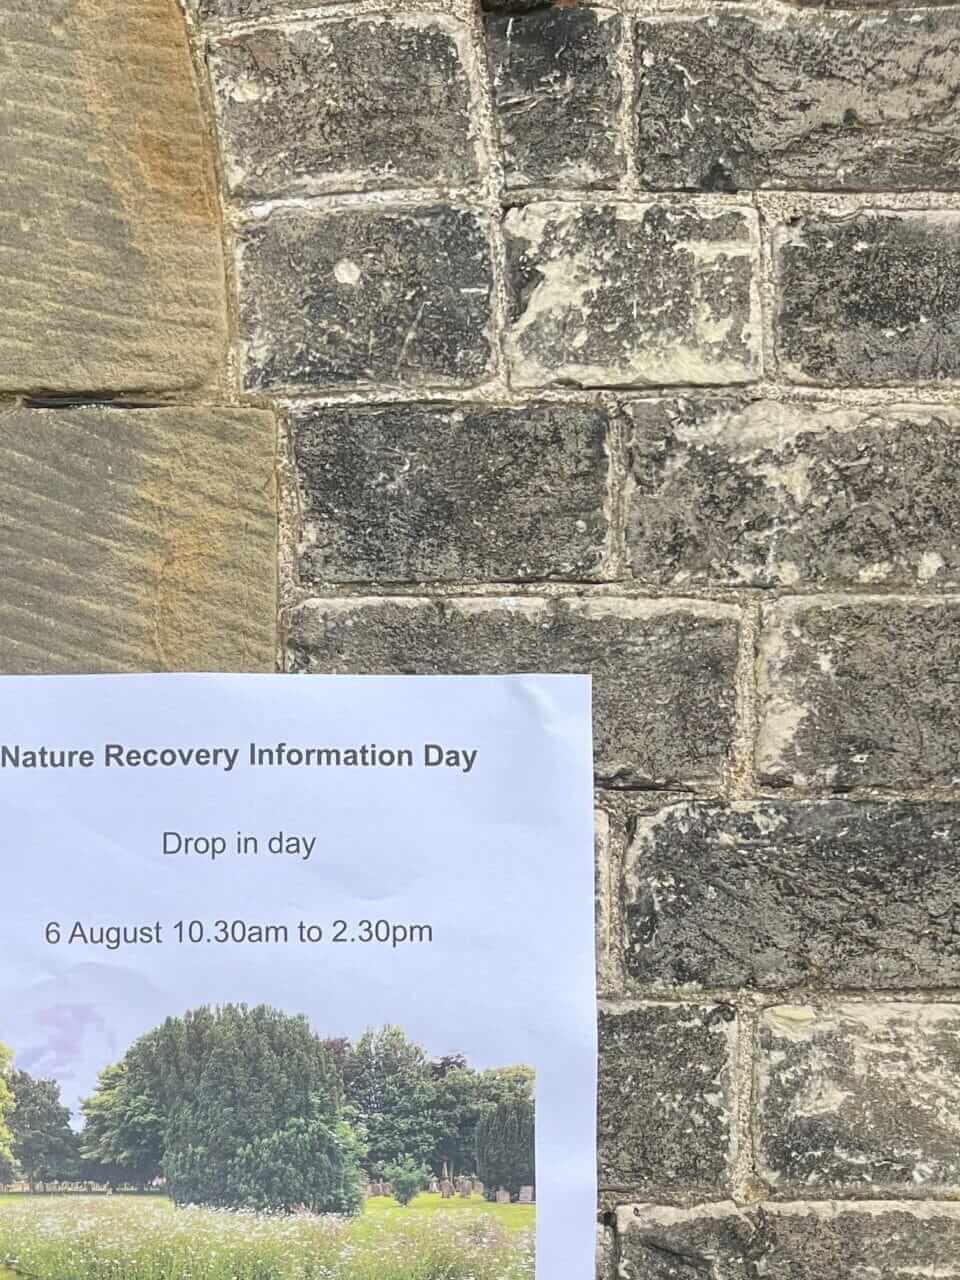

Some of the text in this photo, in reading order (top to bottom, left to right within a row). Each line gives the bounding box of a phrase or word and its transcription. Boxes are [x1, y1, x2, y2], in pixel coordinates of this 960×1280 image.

[0, 742, 478, 773] Nature Recovery Information Day
[162, 831, 317, 861] Drop in day
[44, 919, 434, 950] 6 August 10.30am to 2.30pm
